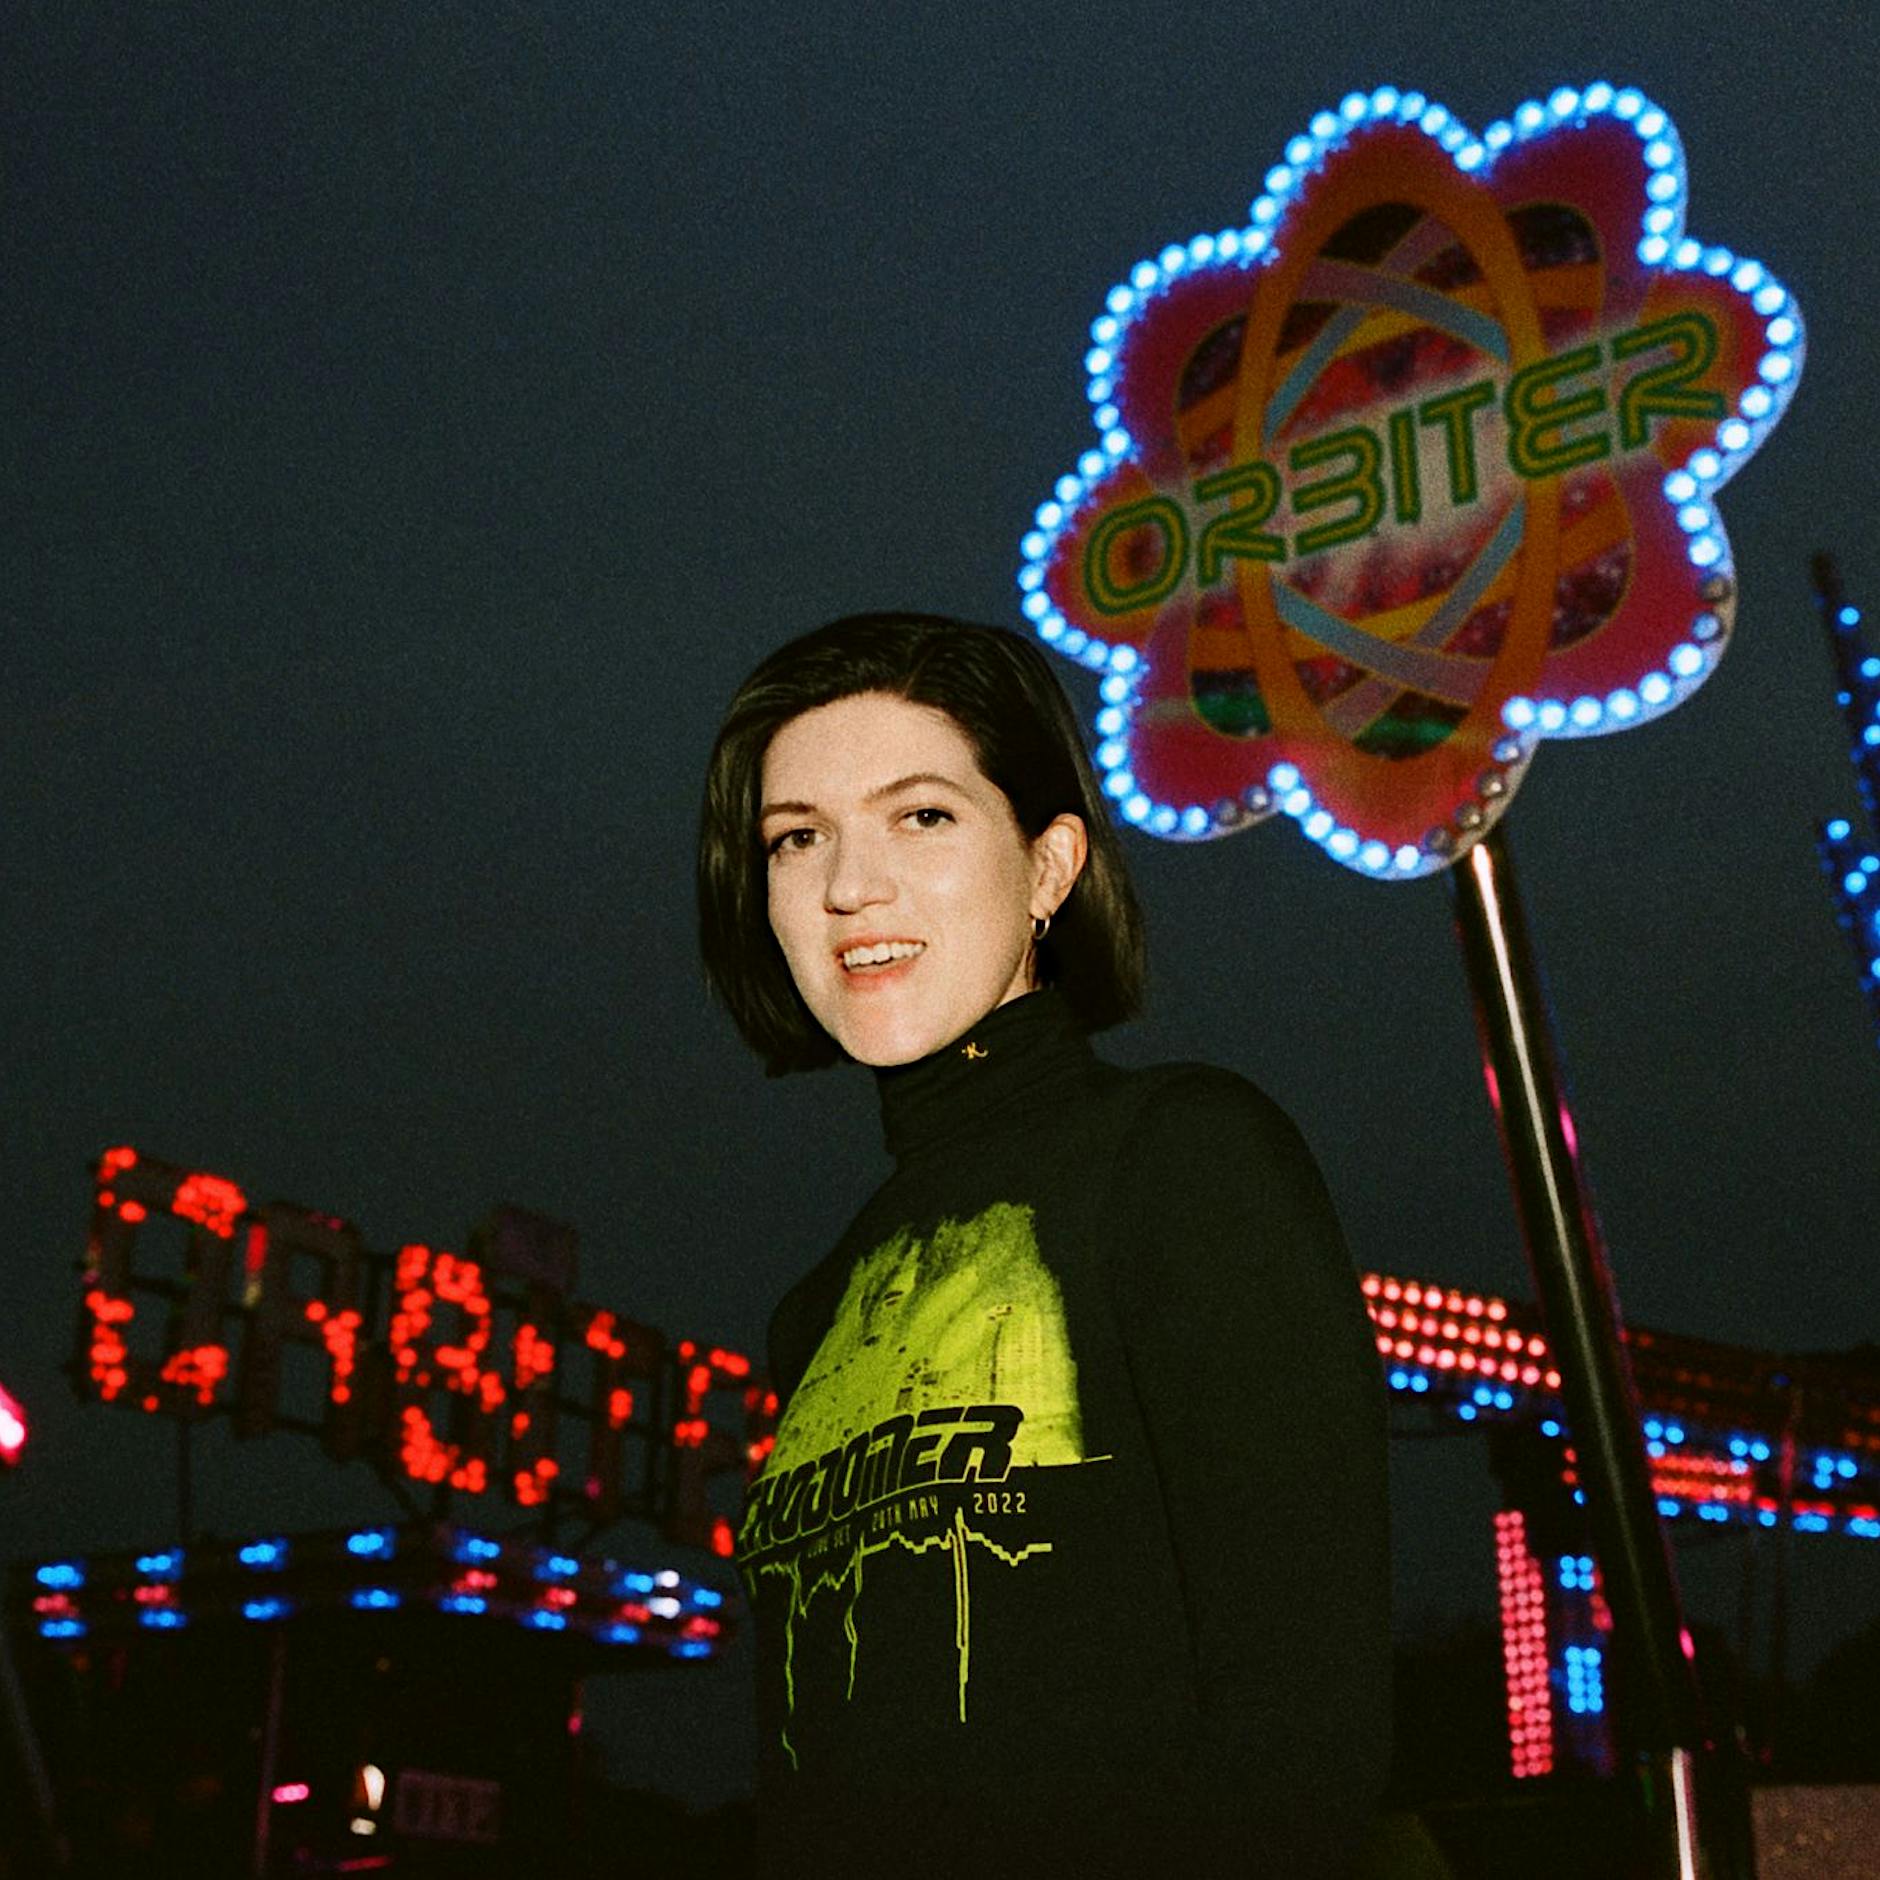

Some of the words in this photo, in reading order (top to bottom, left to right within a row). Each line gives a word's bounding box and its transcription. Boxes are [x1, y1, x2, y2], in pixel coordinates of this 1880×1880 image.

[1082, 310, 1727, 616] ORBITER
[908, 1494, 939, 1520] MAY
[973, 1492, 1026, 1514] 2022
